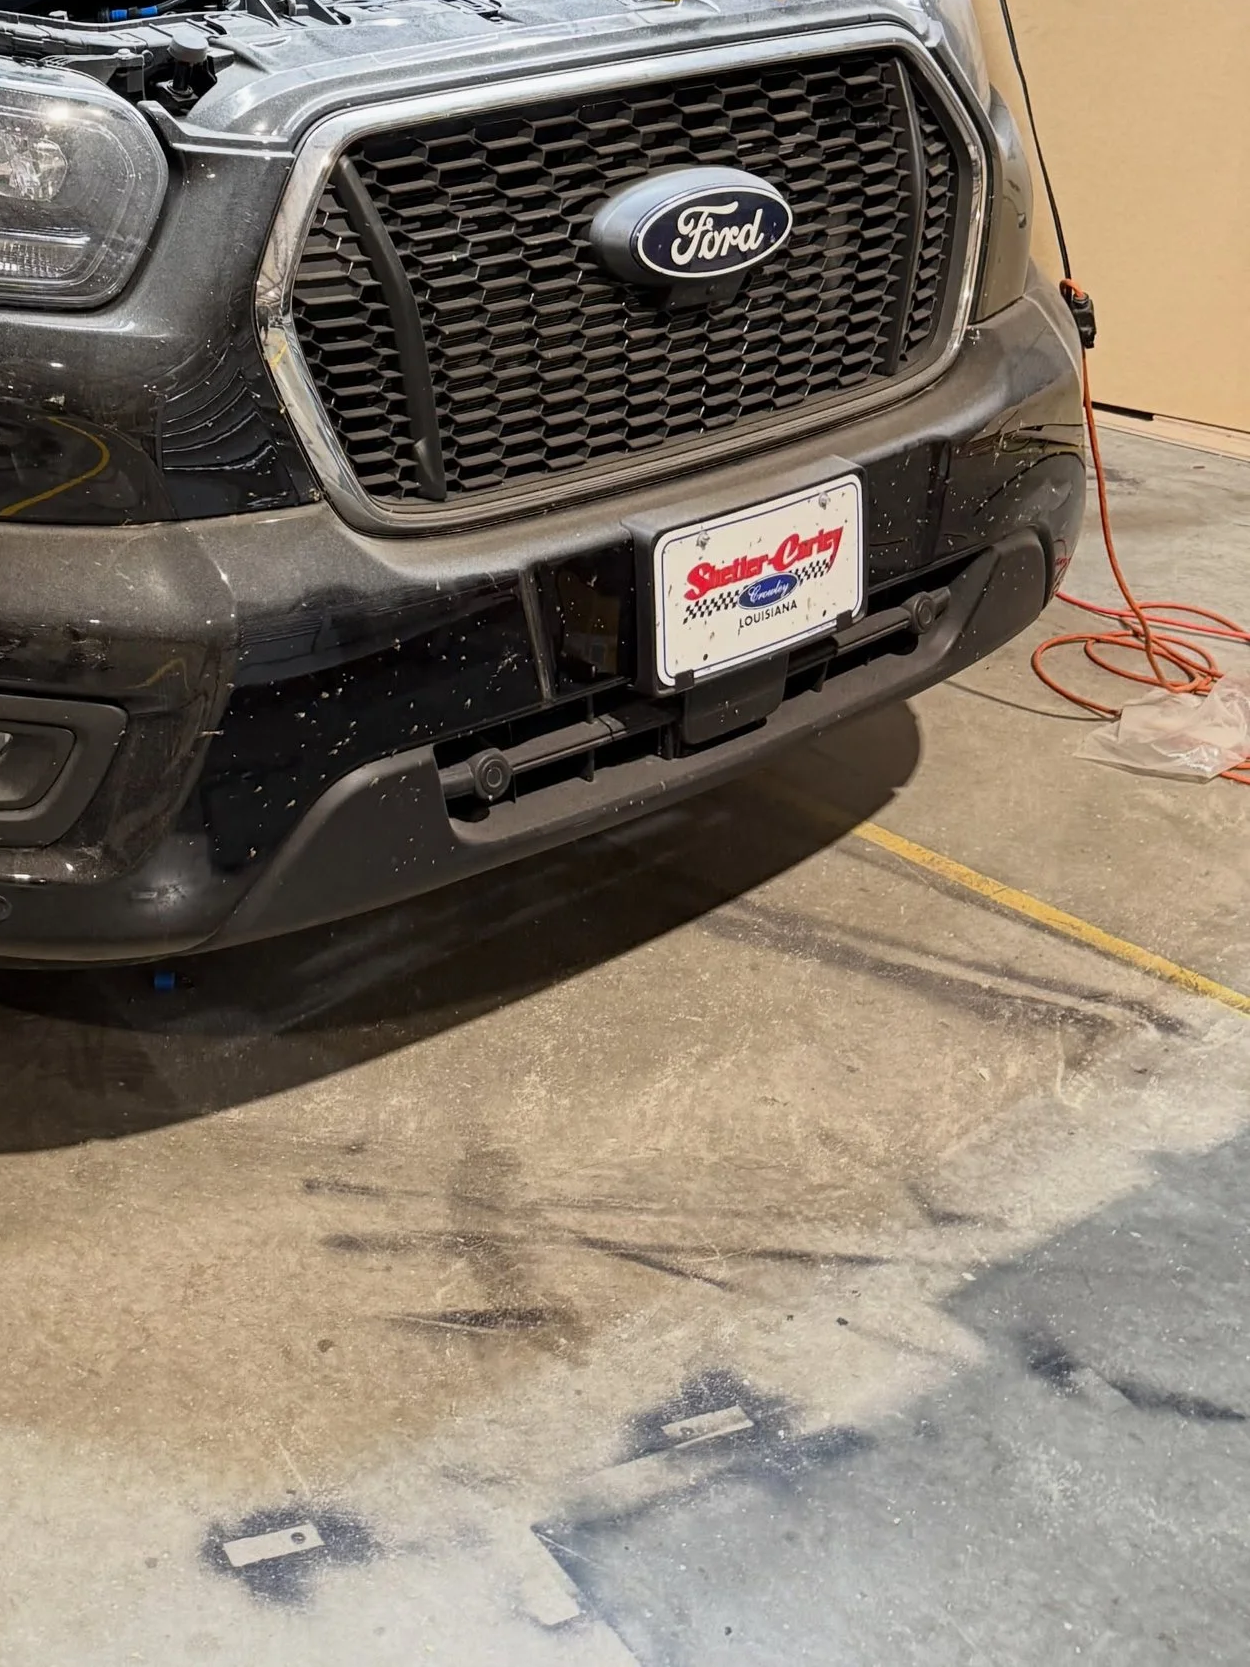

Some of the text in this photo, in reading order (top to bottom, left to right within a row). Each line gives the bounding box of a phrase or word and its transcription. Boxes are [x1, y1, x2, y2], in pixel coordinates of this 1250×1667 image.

[670, 200, 764, 266] Ford
[748, 578, 789, 603] Crowley
[738, 599, 798, 629] LOUISIANA
